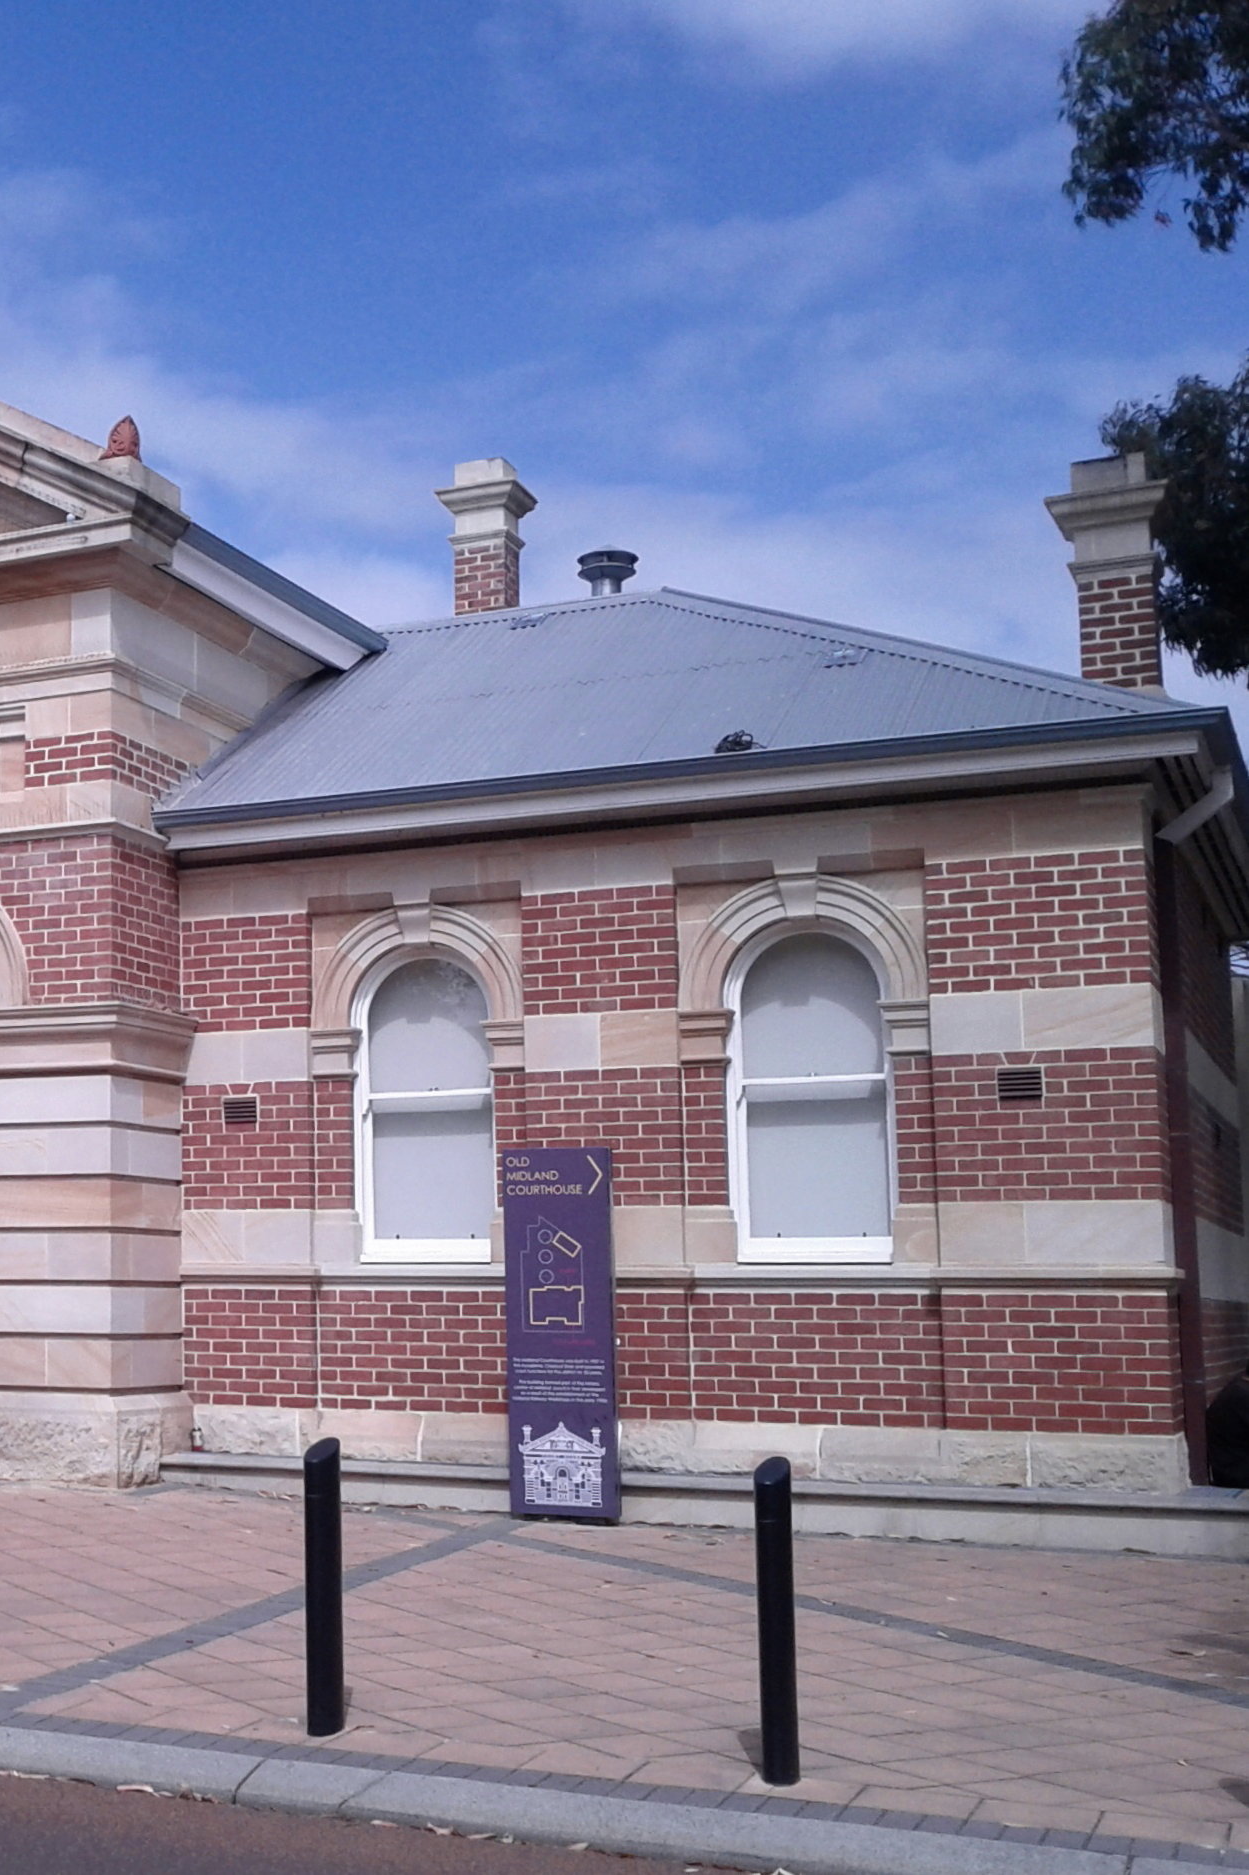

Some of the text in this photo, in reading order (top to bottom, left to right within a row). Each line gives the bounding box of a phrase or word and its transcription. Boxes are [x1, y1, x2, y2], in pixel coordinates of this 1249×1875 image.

[505, 1156, 530, 1168] OLD
[506, 1169, 559, 1181] MIDLAND
[506, 1183, 583, 1196] COURTHOUSE
